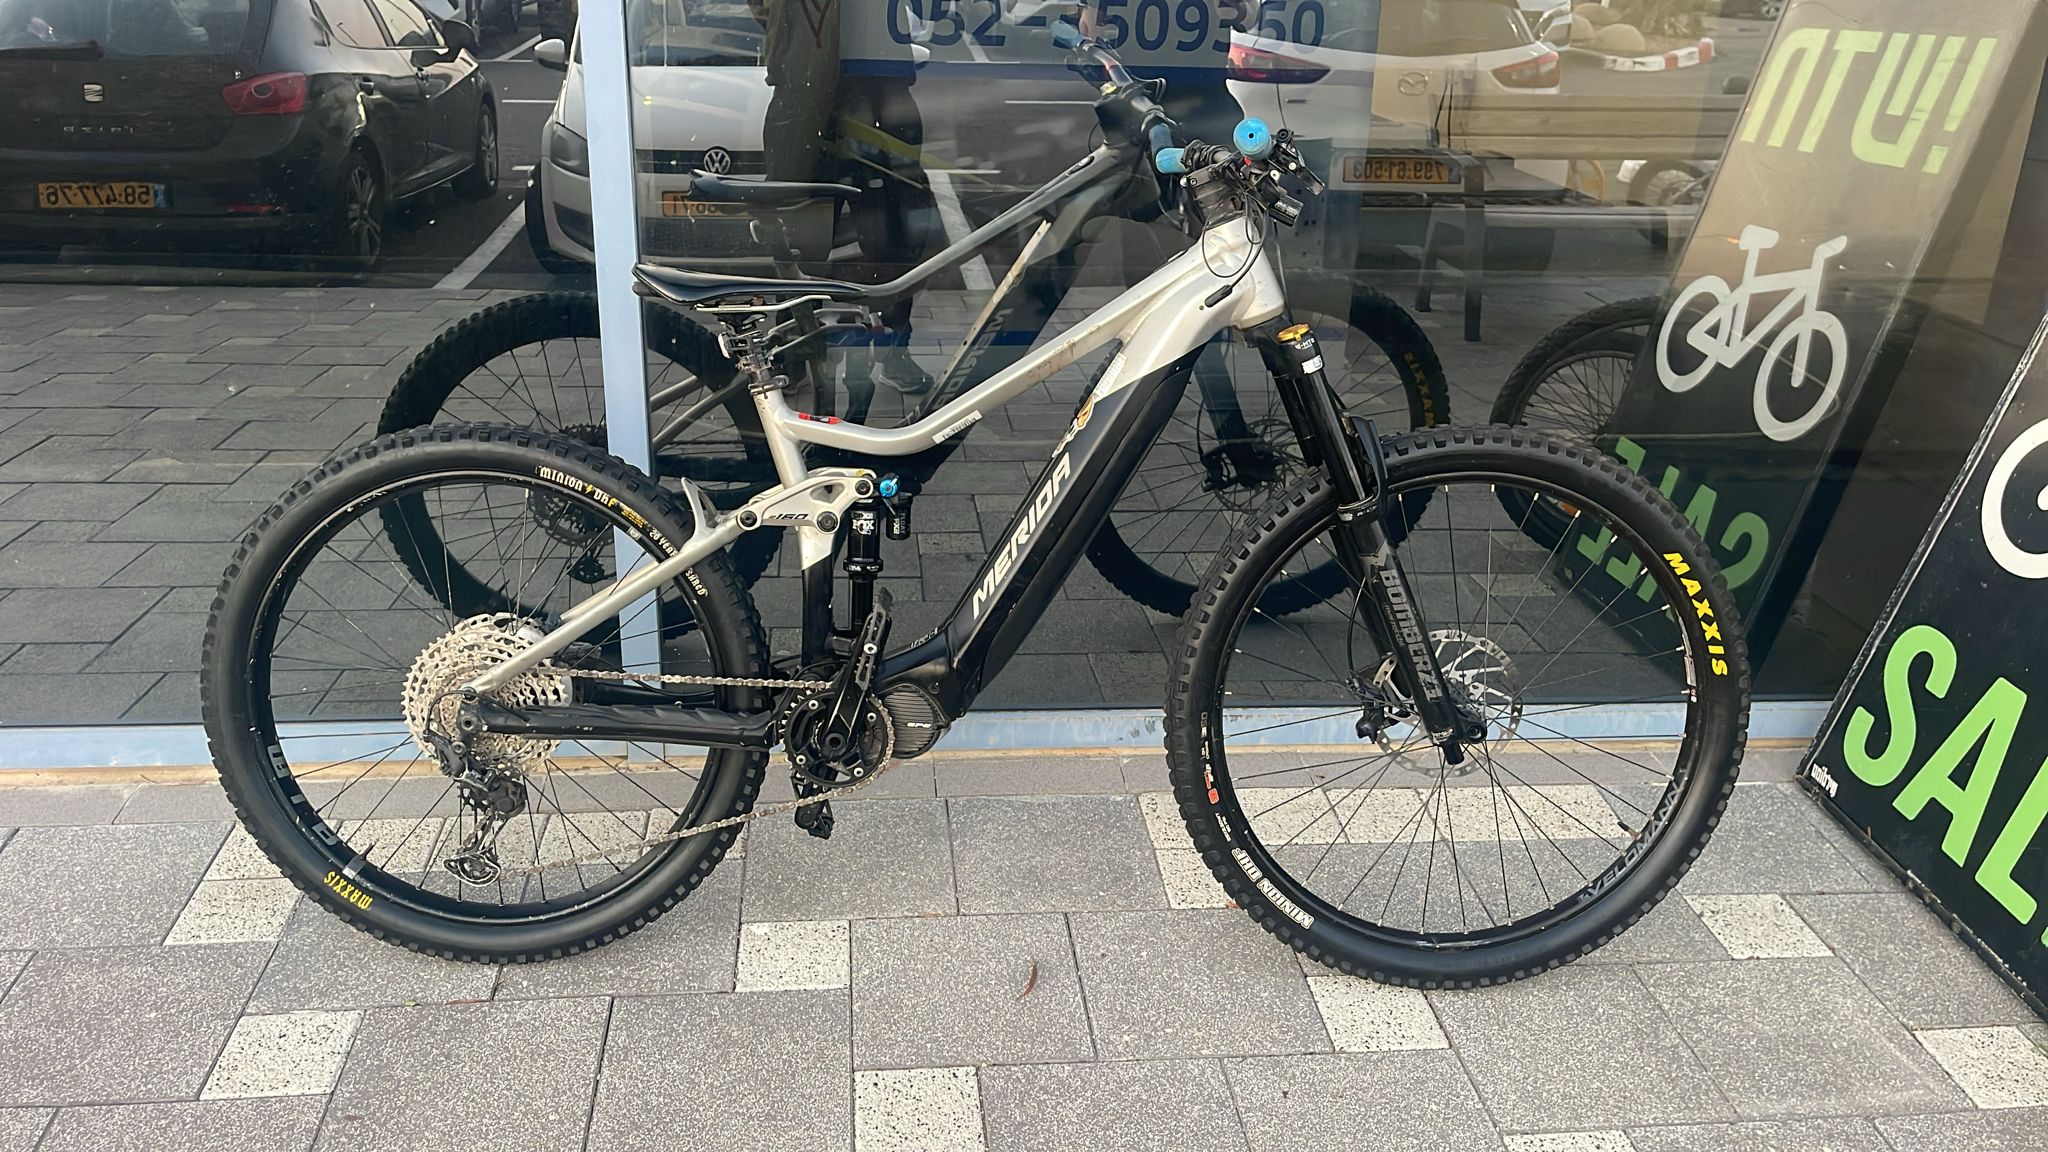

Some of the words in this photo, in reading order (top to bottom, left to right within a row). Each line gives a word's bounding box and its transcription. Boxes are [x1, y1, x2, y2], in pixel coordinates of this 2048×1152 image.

[539, 465, 584, 492] MINION
[852, 520, 875, 533] FOX
[972, 452, 1073, 621] MERIDA
[1663, 552, 1728, 678] MAXXIS
[1843, 624, 2048, 948] SAL
[1231, 847, 1263, 883] DHF
[1585, 781, 1681, 897] VELOMANN
[324, 871, 374, 910] MAXXIS
[1257, 877, 1315, 930] MINION
